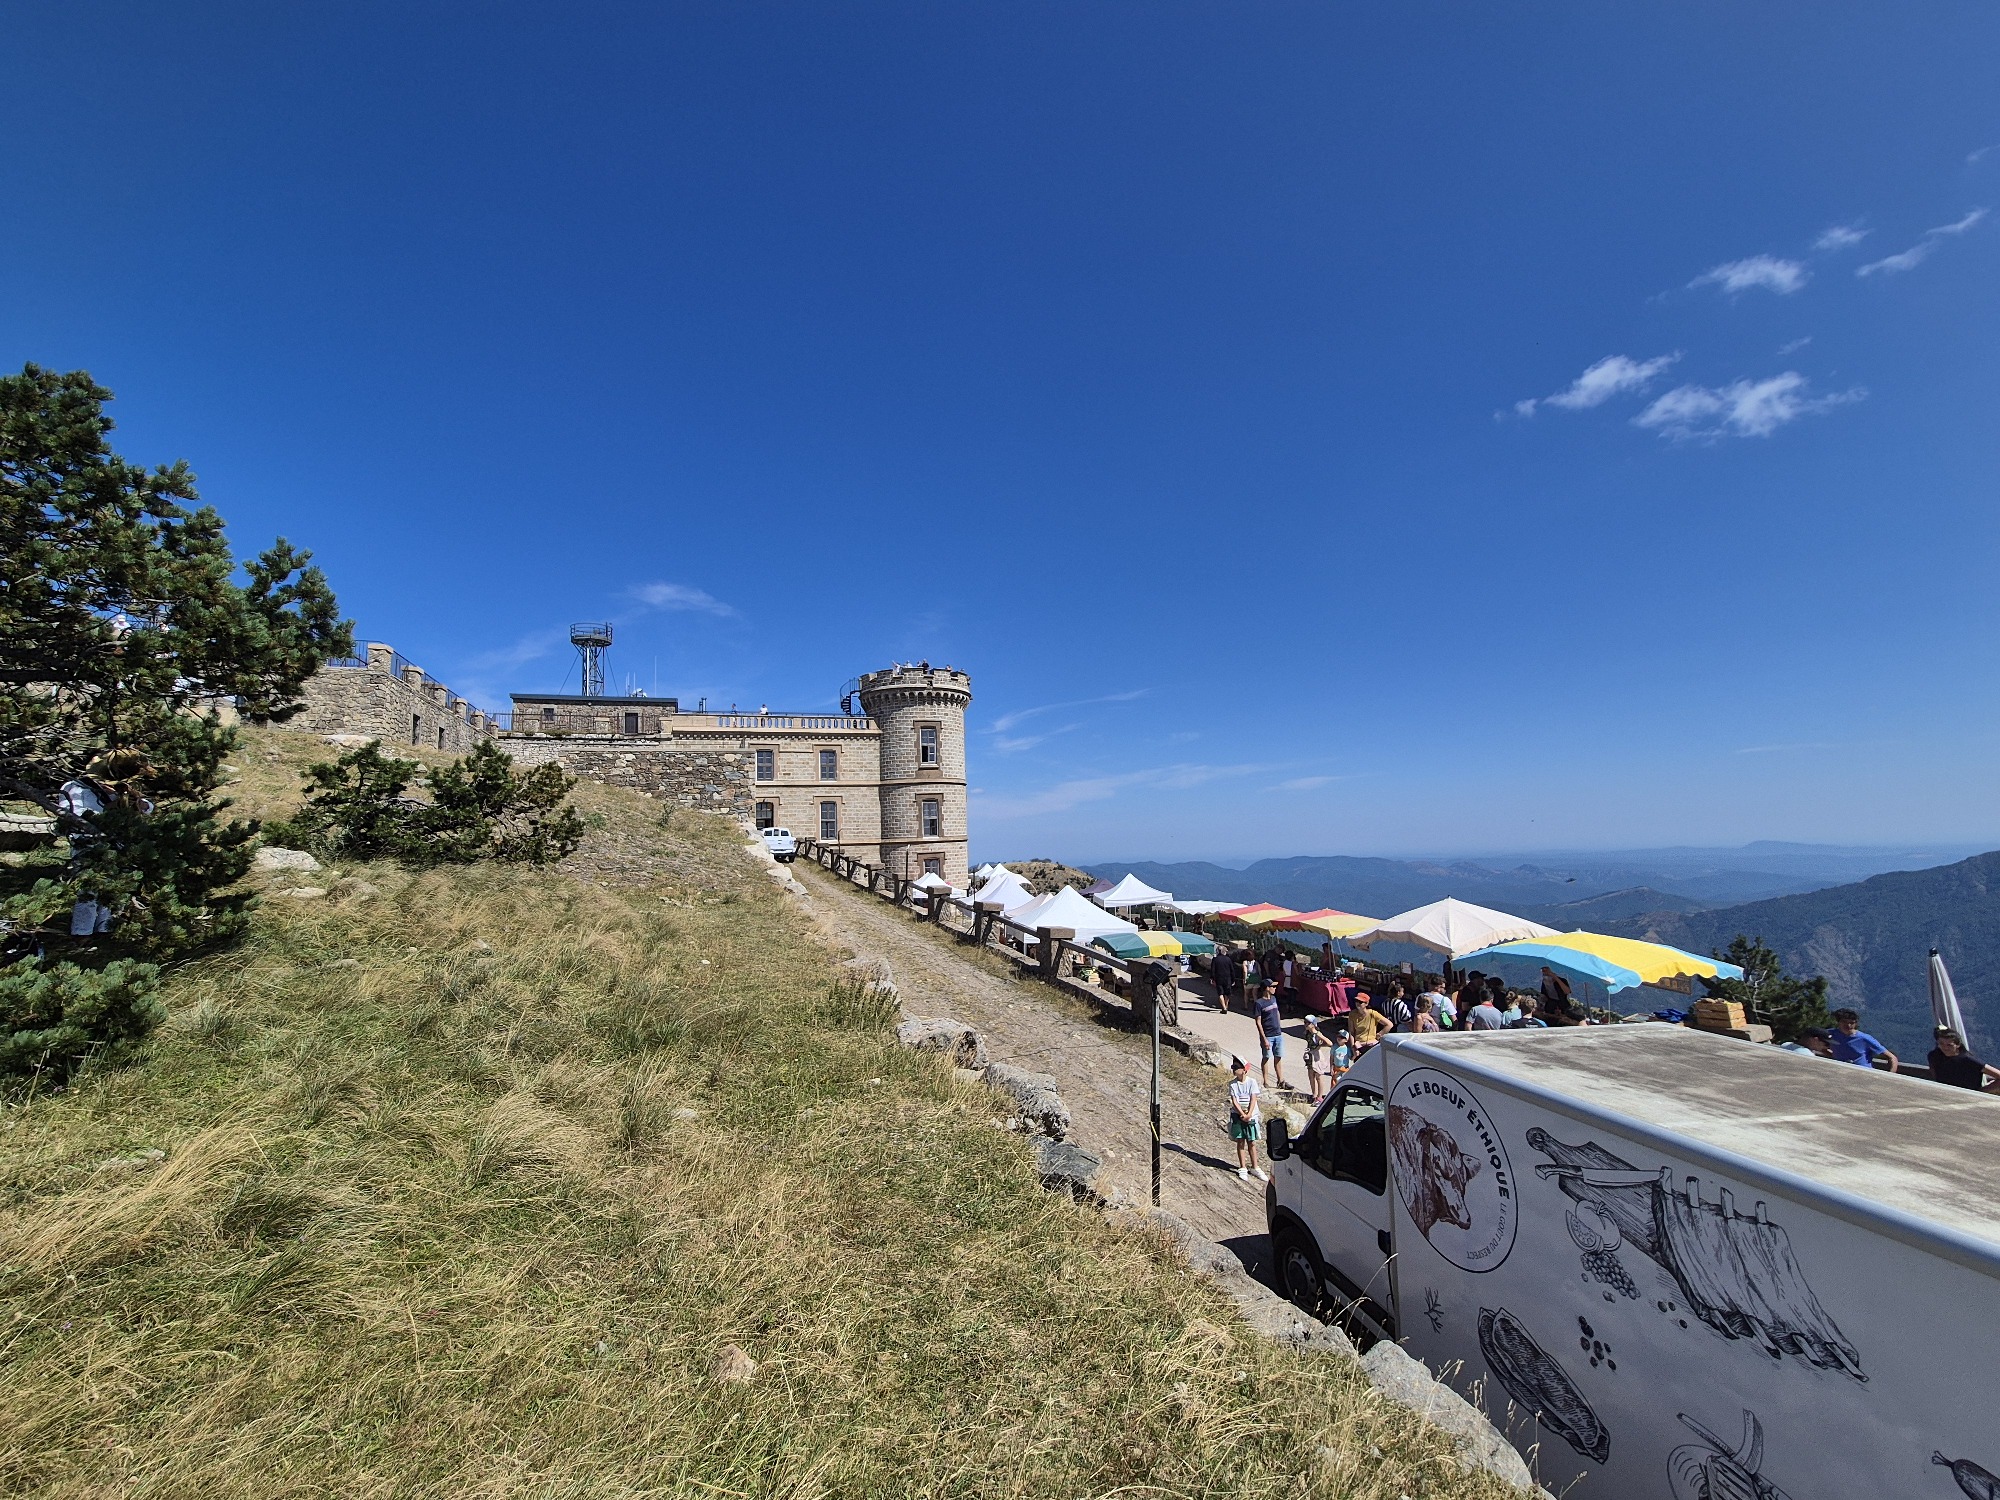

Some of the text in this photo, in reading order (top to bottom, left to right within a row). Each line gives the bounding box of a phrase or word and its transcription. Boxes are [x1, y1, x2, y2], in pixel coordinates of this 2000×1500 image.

[1408, 1081, 1510, 1199] LE BOEUF ÉTHIQUE
[1500, 1202, 1507, 1215] LE
[1489, 1238, 1499, 1251] DU
[1466, 1246, 1492, 1260] RESPECT
